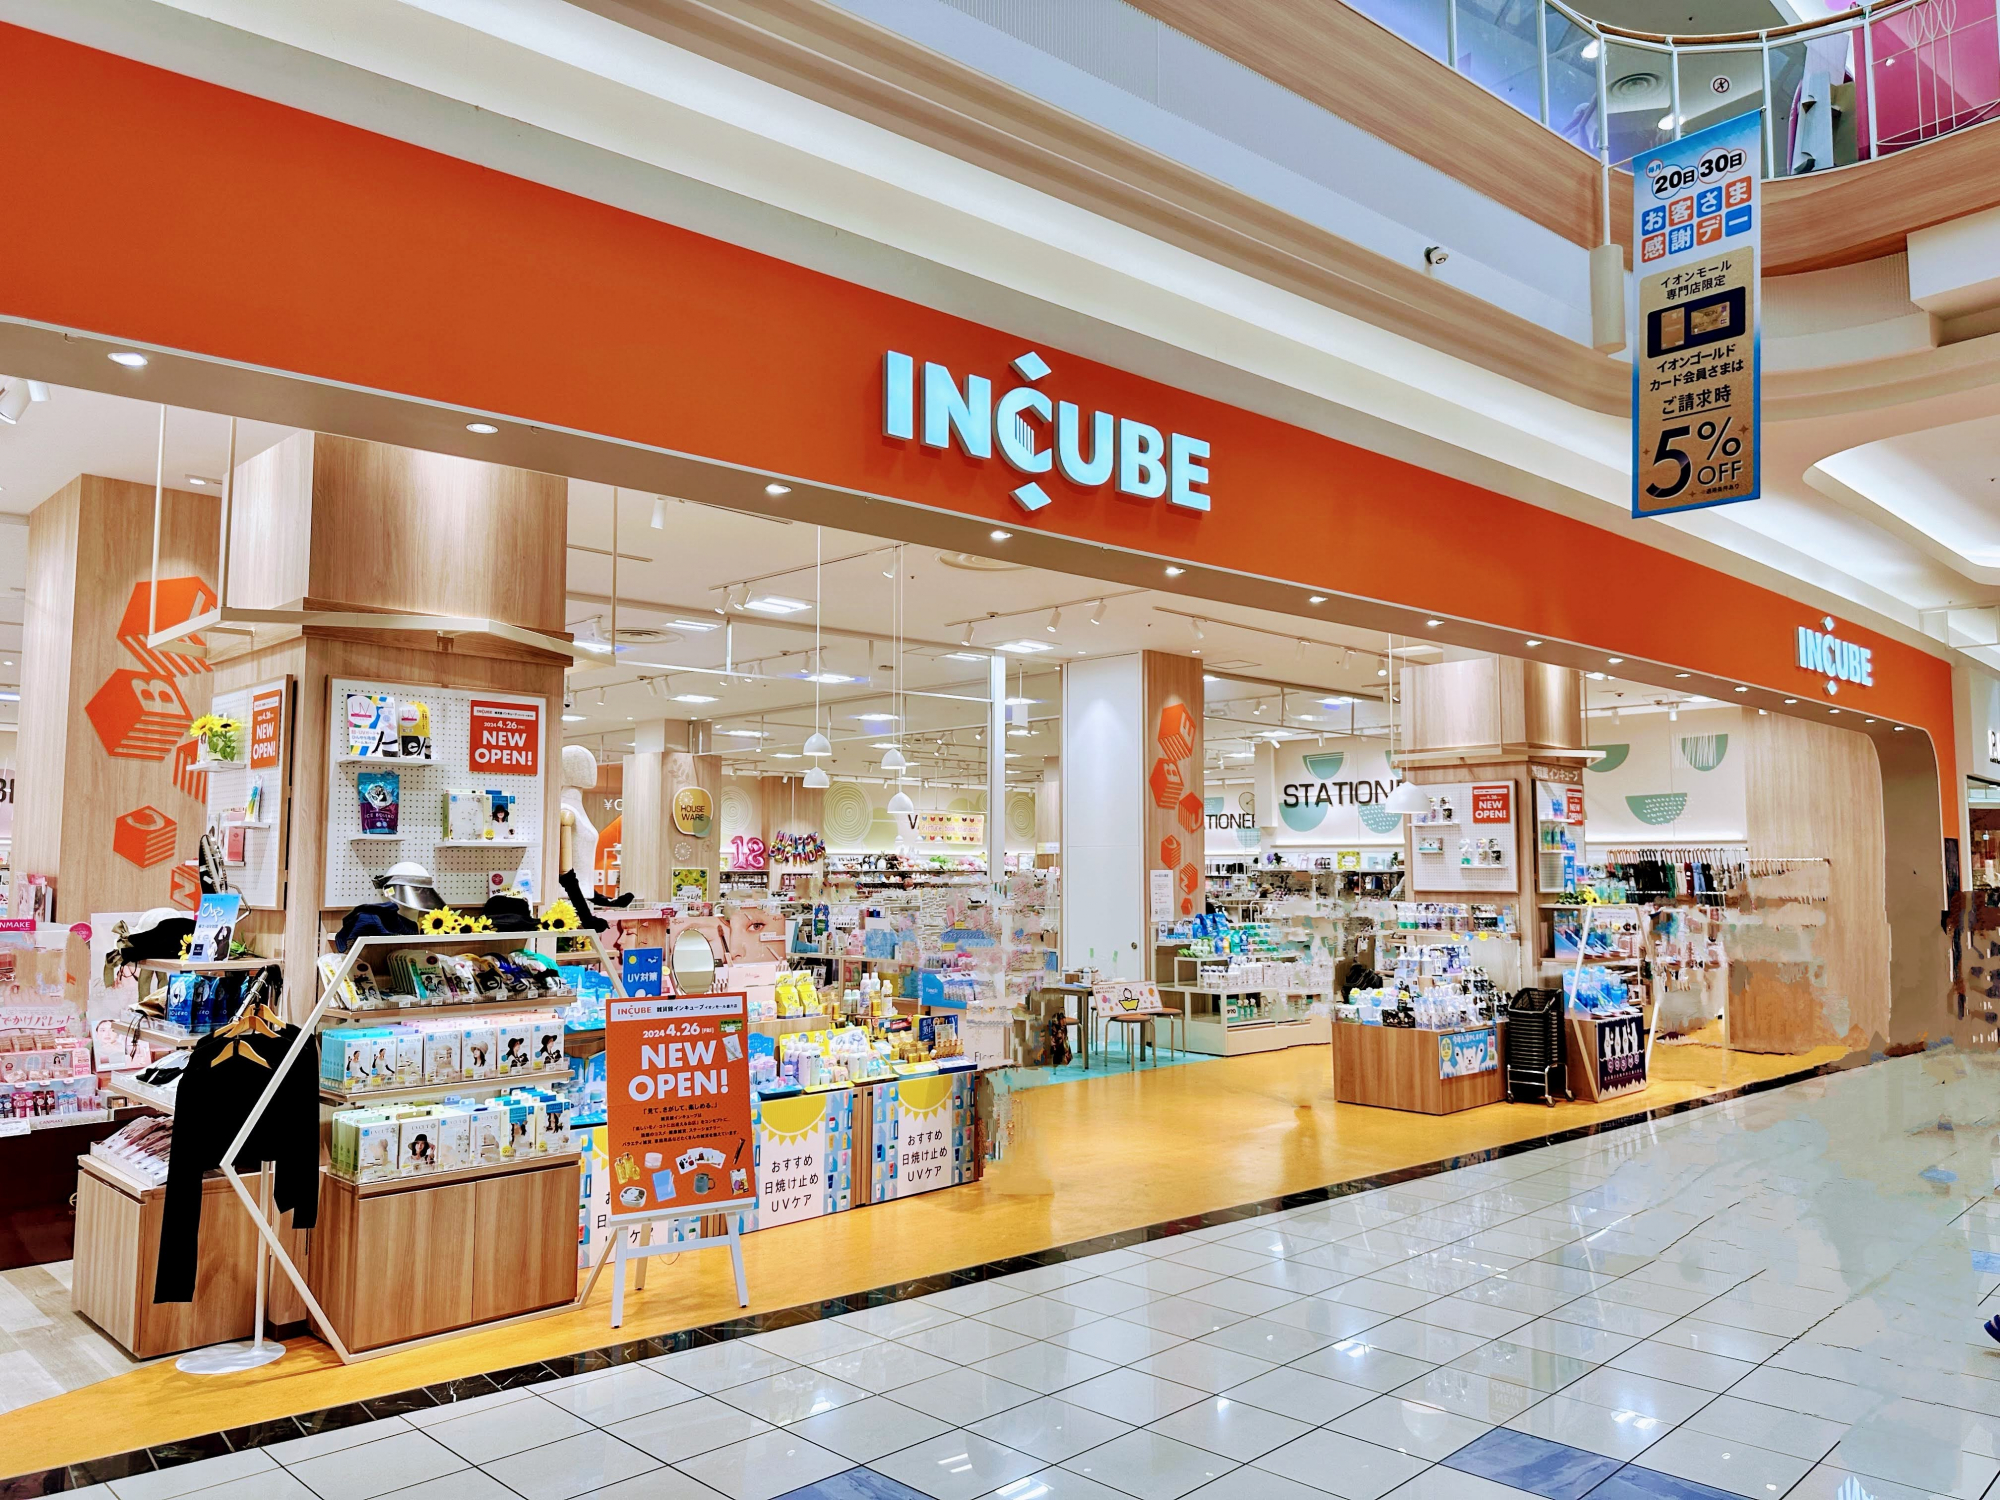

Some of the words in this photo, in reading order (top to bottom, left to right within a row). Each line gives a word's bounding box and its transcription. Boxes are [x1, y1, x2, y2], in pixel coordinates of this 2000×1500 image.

[1644, 181, 1748, 231] お客さま
[1644, 216, 1749, 260] 感謝デー
[1661, 260, 1732, 289] イオンモール
[1666, 274, 1726, 301] 専門店限定
[1657, 343, 1736, 373] イオンゴールド
[1650, 359, 1744, 392] カード会員さまは
[1662, 384, 1732, 415] ご請求時
[882, 350, 1211, 512] INCUBE
[1697, 460, 1743, 486] OFF
[1795, 621, 1873, 690] INCUBE
[256, 721, 275, 740] NEW
[497, 720, 518, 730] 4.26
[482, 730, 527, 748] NEW
[253, 741, 276, 760] OPEN!
[474, 747, 533, 766] OPEN!
[681, 804, 705, 813] HOUSE
[1475, 810, 1507, 818] OPEN!
[1478, 801, 1503, 809] NEW
[1569, 804, 1581, 812] NEW
[682, 813, 705, 821] WARE
[627, 971, 658, 983] UV対策
[617, 1005, 652, 1016] INCUBE
[643, 1029, 665, 1038] 2024
[666, 1023, 700, 1036] 4.26
[641, 1040, 717, 1070] NEW
[628, 1068, 729, 1101] OPEN!
[907, 1129, 943, 1147] おすすめ
[771, 1154, 814, 1173] おすすめ
[902, 1146, 948, 1167] 日焼け止め
[907, 1165, 942, 1182] UVケア
[764, 1174, 819, 1196] 日焼け止め
[771, 1193, 812, 1213] UVケア
